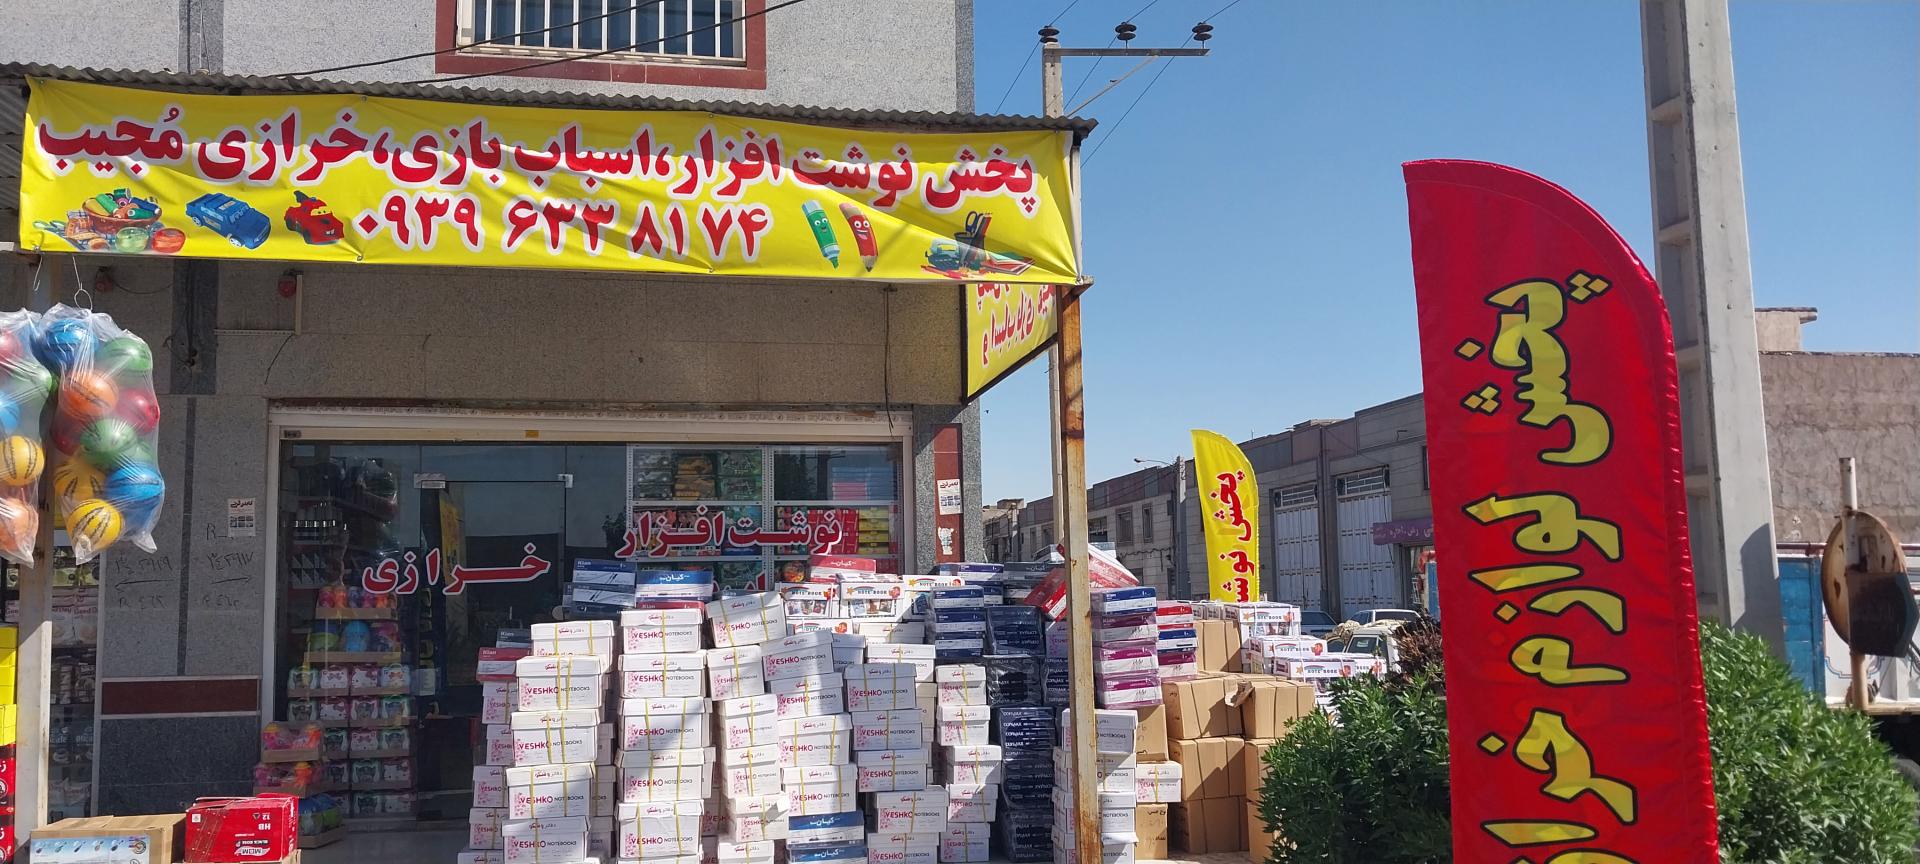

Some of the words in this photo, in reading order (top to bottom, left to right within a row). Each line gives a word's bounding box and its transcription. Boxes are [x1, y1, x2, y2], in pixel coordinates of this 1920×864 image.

[792, 145, 913, 207] نوشت
[924, 146, 1034, 214] پخش
[358, 195, 479, 247] ۰۹۳۹
[1454, 268, 1614, 467] پخش
[1209, 469, 1253, 543] پخش
[614, 503, 725, 558] افزار
[727, 509, 843, 556] نوشت
[362, 542, 552, 596] خرازی
[1218, 549, 1256, 602] نوش
[1461, 490, 1631, 687] لوازم
[633, 631, 664, 639] VESHKO
[633, 674, 665, 682] VESHKO
[771, 655, 800, 665] VESHKO
[527, 686, 559, 694] VESHKO
[633, 727, 666, 736] VESHKO
[865, 769, 893, 778] VESHKO
[257, 822, 271, 831] HB
[884, 810, 914, 819] VESHKO
[875, 851, 904, 860] VESHKO
